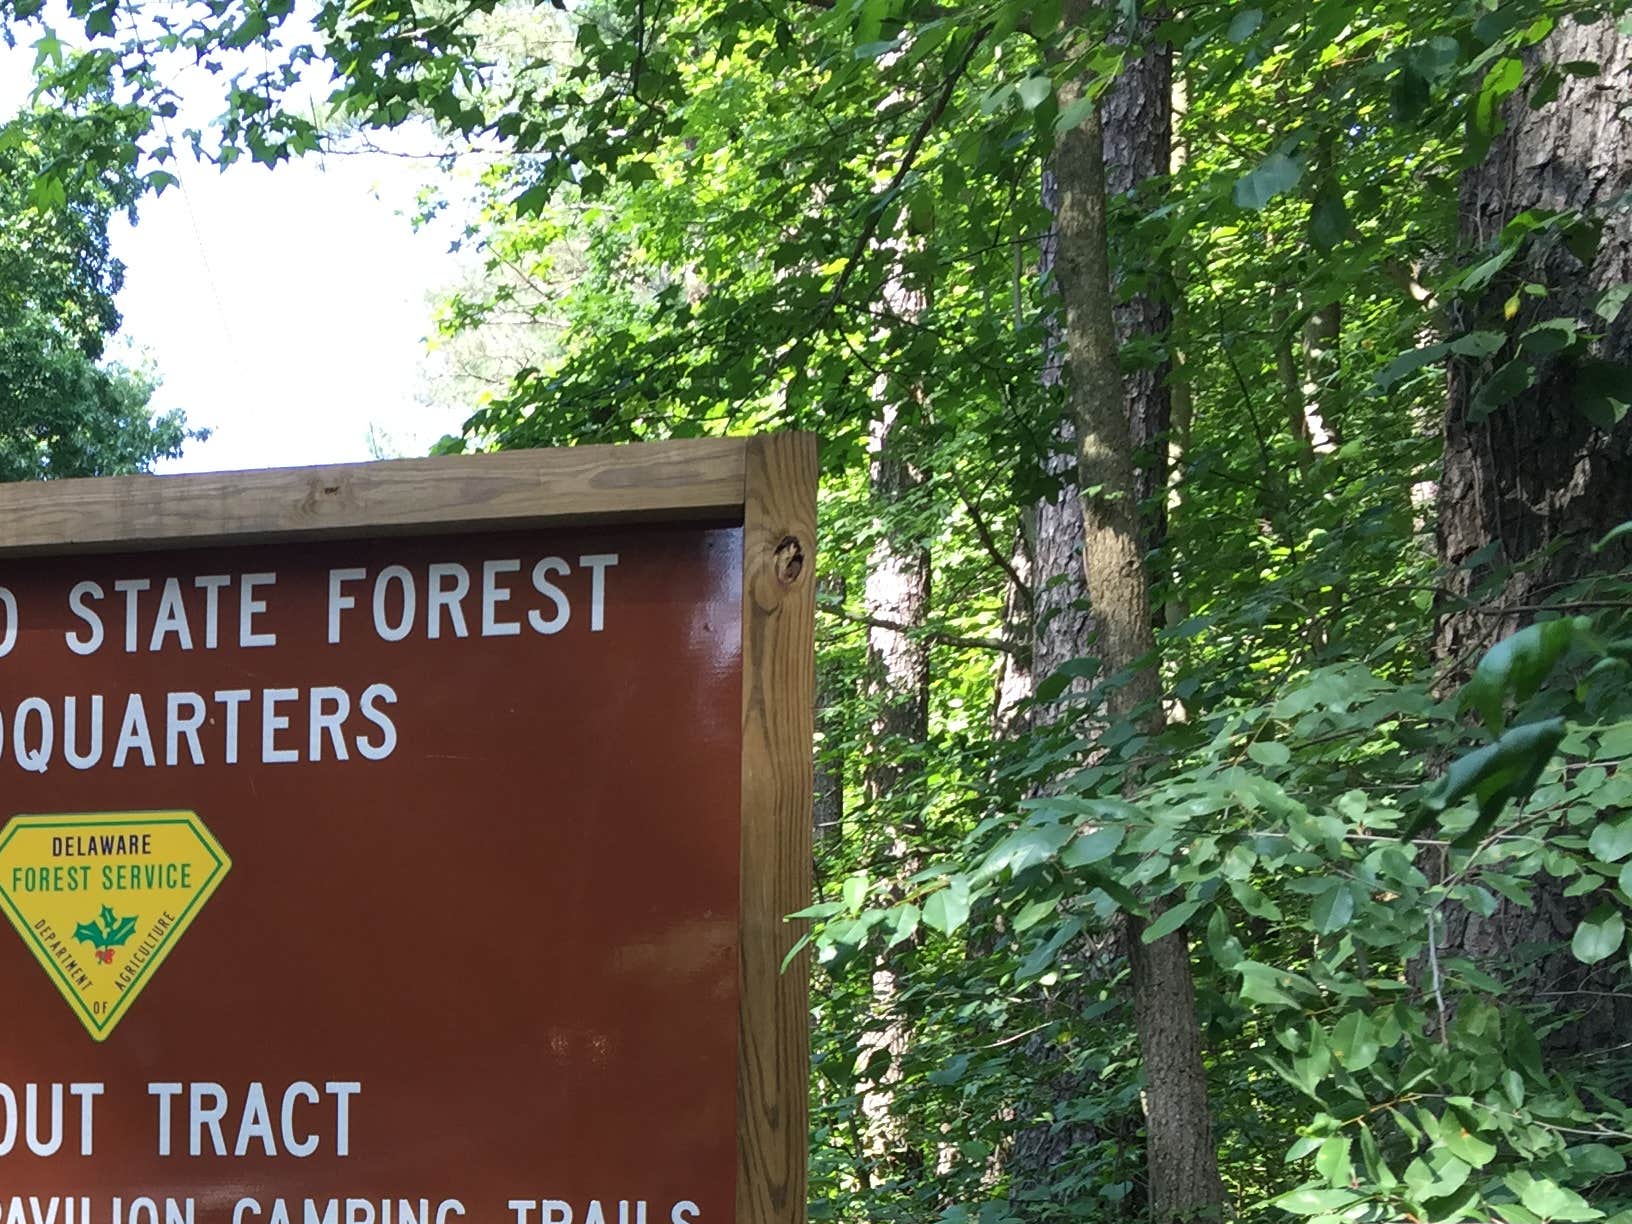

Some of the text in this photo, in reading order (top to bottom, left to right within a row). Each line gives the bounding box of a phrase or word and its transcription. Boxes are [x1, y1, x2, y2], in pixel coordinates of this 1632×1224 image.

[65, 573, 277, 655] STATE
[328, 555, 618, 644] FOREST
[13, 863, 192, 892] FOREST SERVICE
[52, 834, 152, 857] DELAWARE
[34, 919, 93, 991] DEPARTMENT
[114, 911, 175, 992] AGRICULTURE
[93, 1001, 108, 1014] OF
[147, 1081, 361, 1158] TRACT
